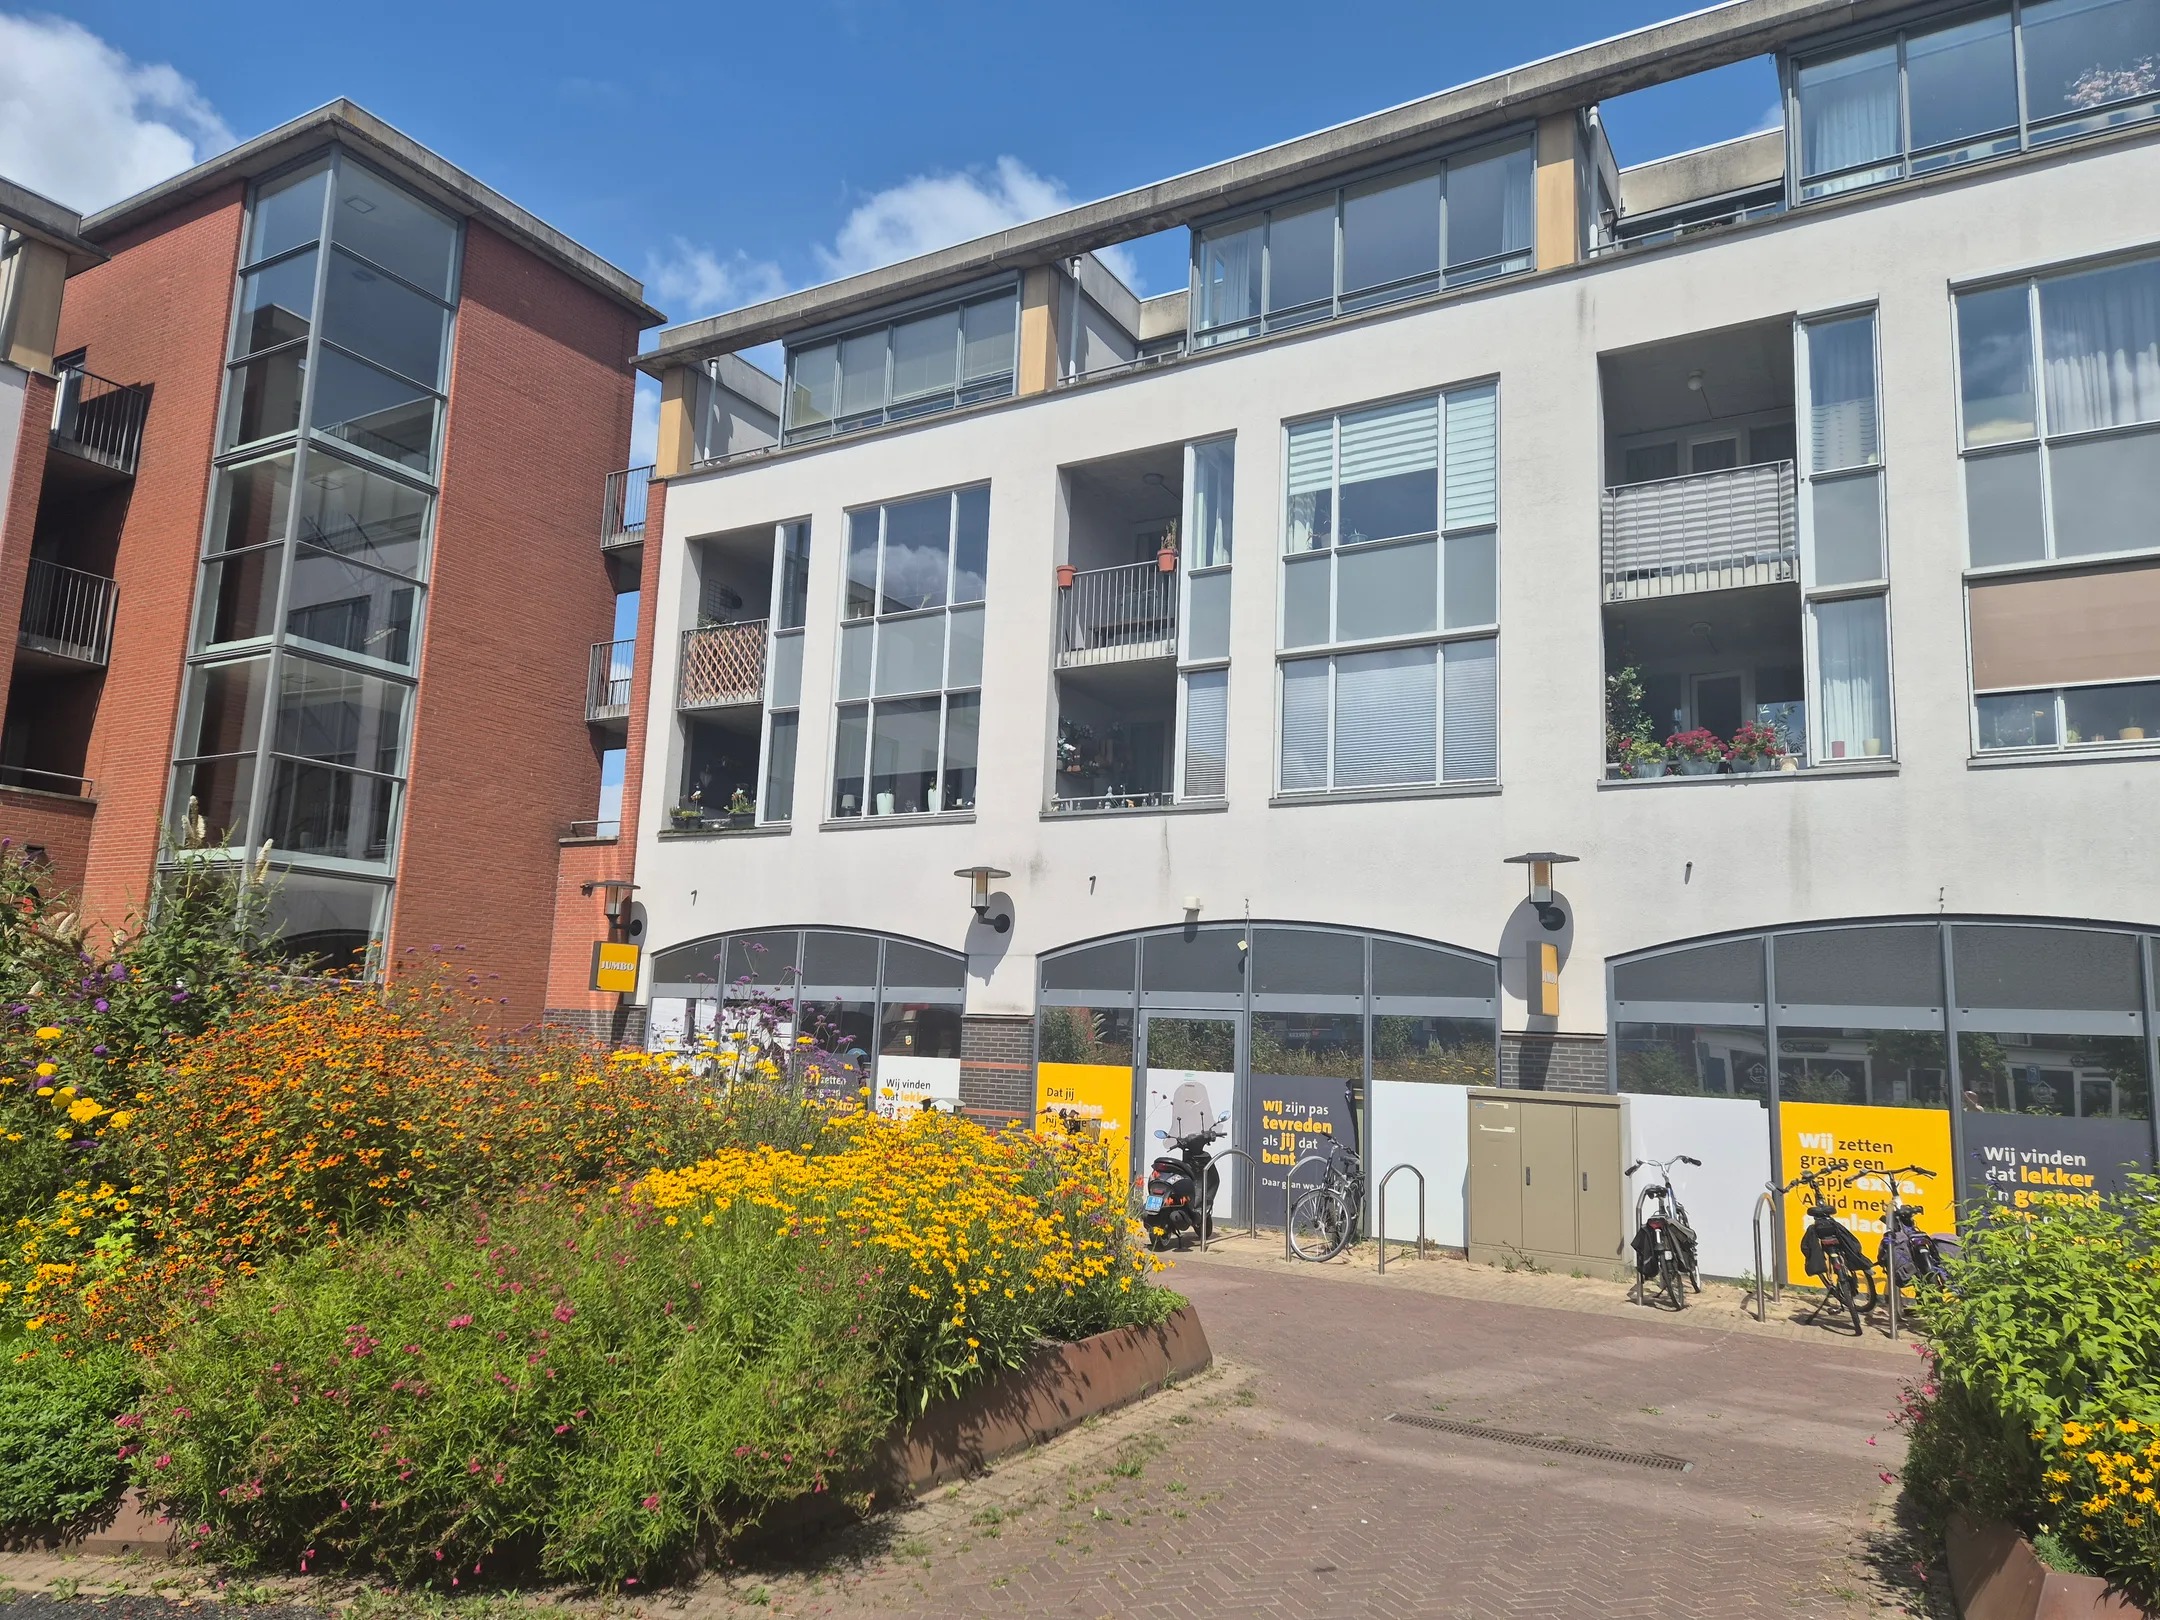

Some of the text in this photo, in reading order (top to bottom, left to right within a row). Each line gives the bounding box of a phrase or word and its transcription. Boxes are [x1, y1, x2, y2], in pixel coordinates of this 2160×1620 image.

[601, 960, 635, 971] JUMBO
[886, 1078, 931, 1091] Wij vinden
[1046, 1087, 1075, 1101] Dat jij
[1262, 1100, 1329, 1118] Wij zijn pas
[1262, 1115, 1333, 1134] tevreden
[1262, 1132, 1318, 1152] als jij dat
[1798, 1131, 1894, 1155] Wij zetten
[1800, 1155, 1885, 1172] graag een
[1983, 1146, 2087, 1167] Wij vinden
[1262, 1178, 1281, 1187] Daar
[1281, 1181, 1301, 1190] gan
[1802, 1174, 1852, 1191] apje
[1985, 1165, 2095, 1188] dat lekker
[1802, 1193, 1848, 1210] Aijd
